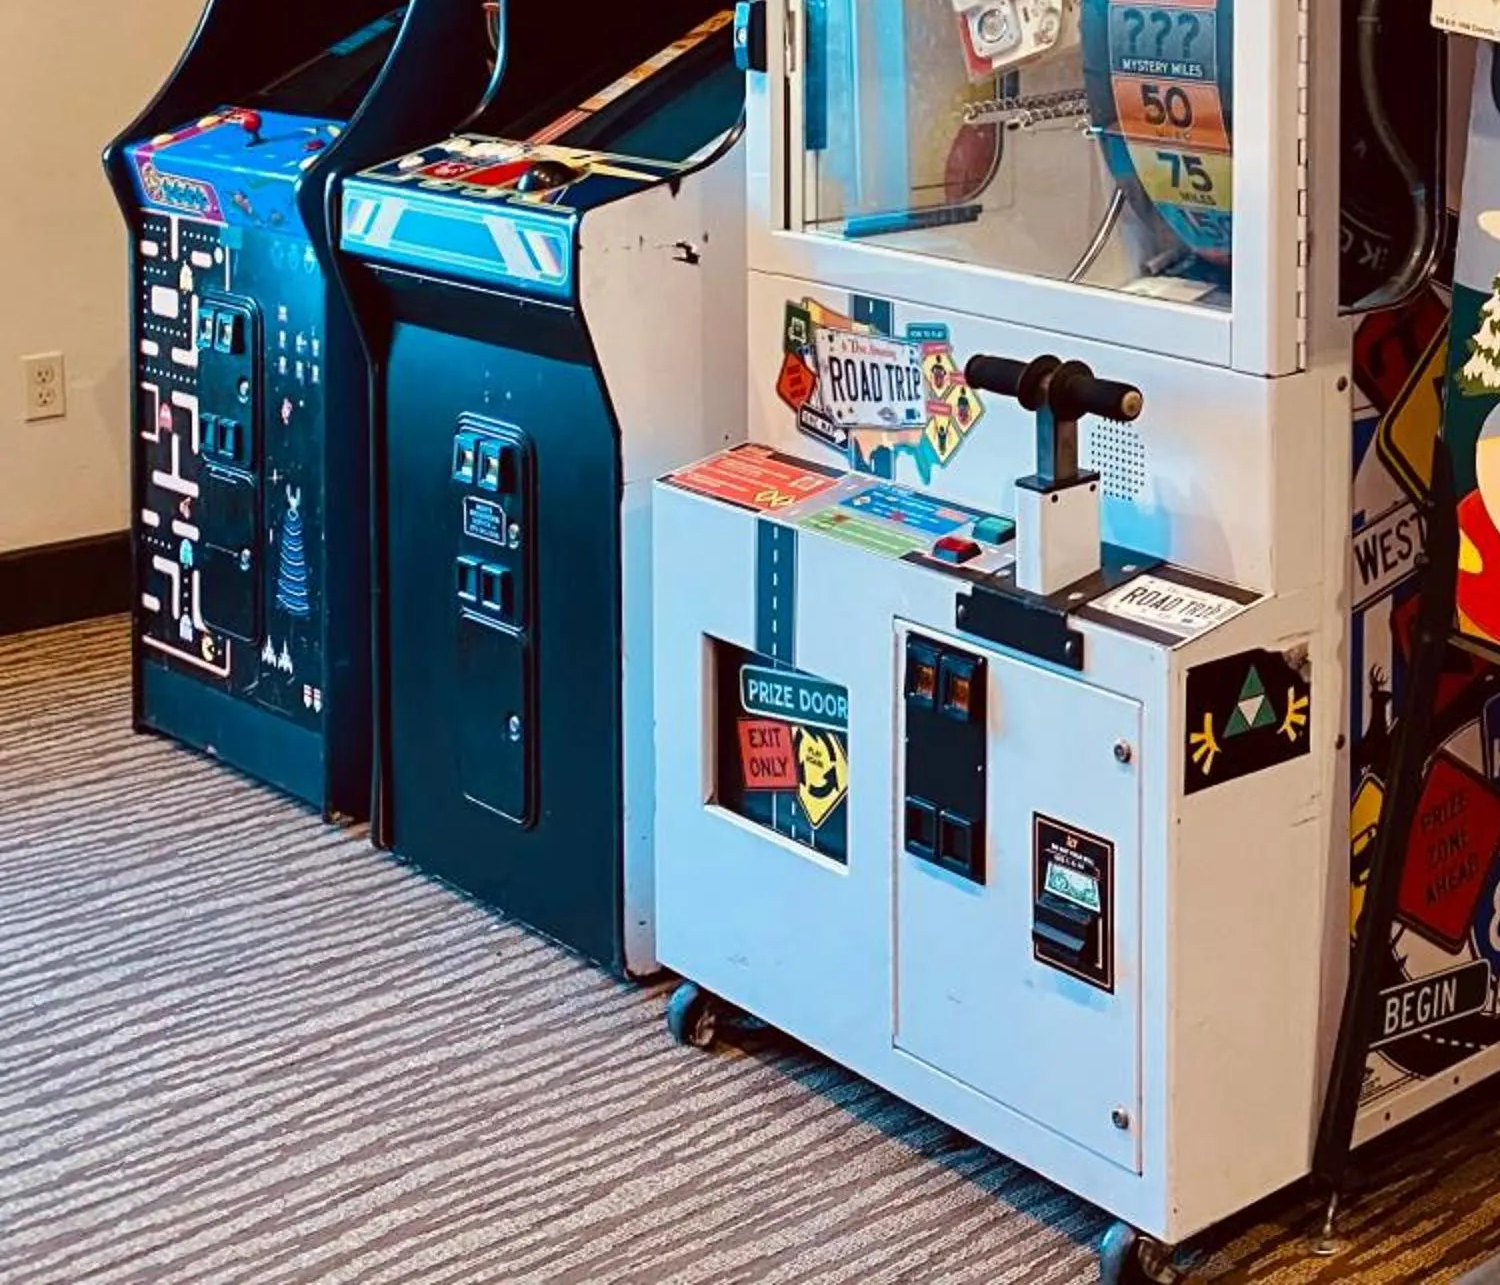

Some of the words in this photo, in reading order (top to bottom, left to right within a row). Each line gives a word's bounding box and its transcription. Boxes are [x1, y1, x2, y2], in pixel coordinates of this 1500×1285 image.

[1122, 58, 1168, 74] MYSTERY
[1171, 60, 1203, 76] MILES
[1140, 84, 1193, 129] 50
[1156, 152, 1213, 192] 75
[829, 356, 884, 403] ROAD
[885, 364, 921, 402] TRIP
[1354, 515, 1427, 586] WEST
[1120, 586, 1184, 612] ROAD
[1179, 598, 1223, 618] TRIP
[748, 678, 795, 709] PRIZE
[799, 688, 848, 720] DOOR
[748, 726, 781, 749] EXIT
[748, 756, 788, 778] ONLY
[1383, 978, 1458, 1035] BEGIN
